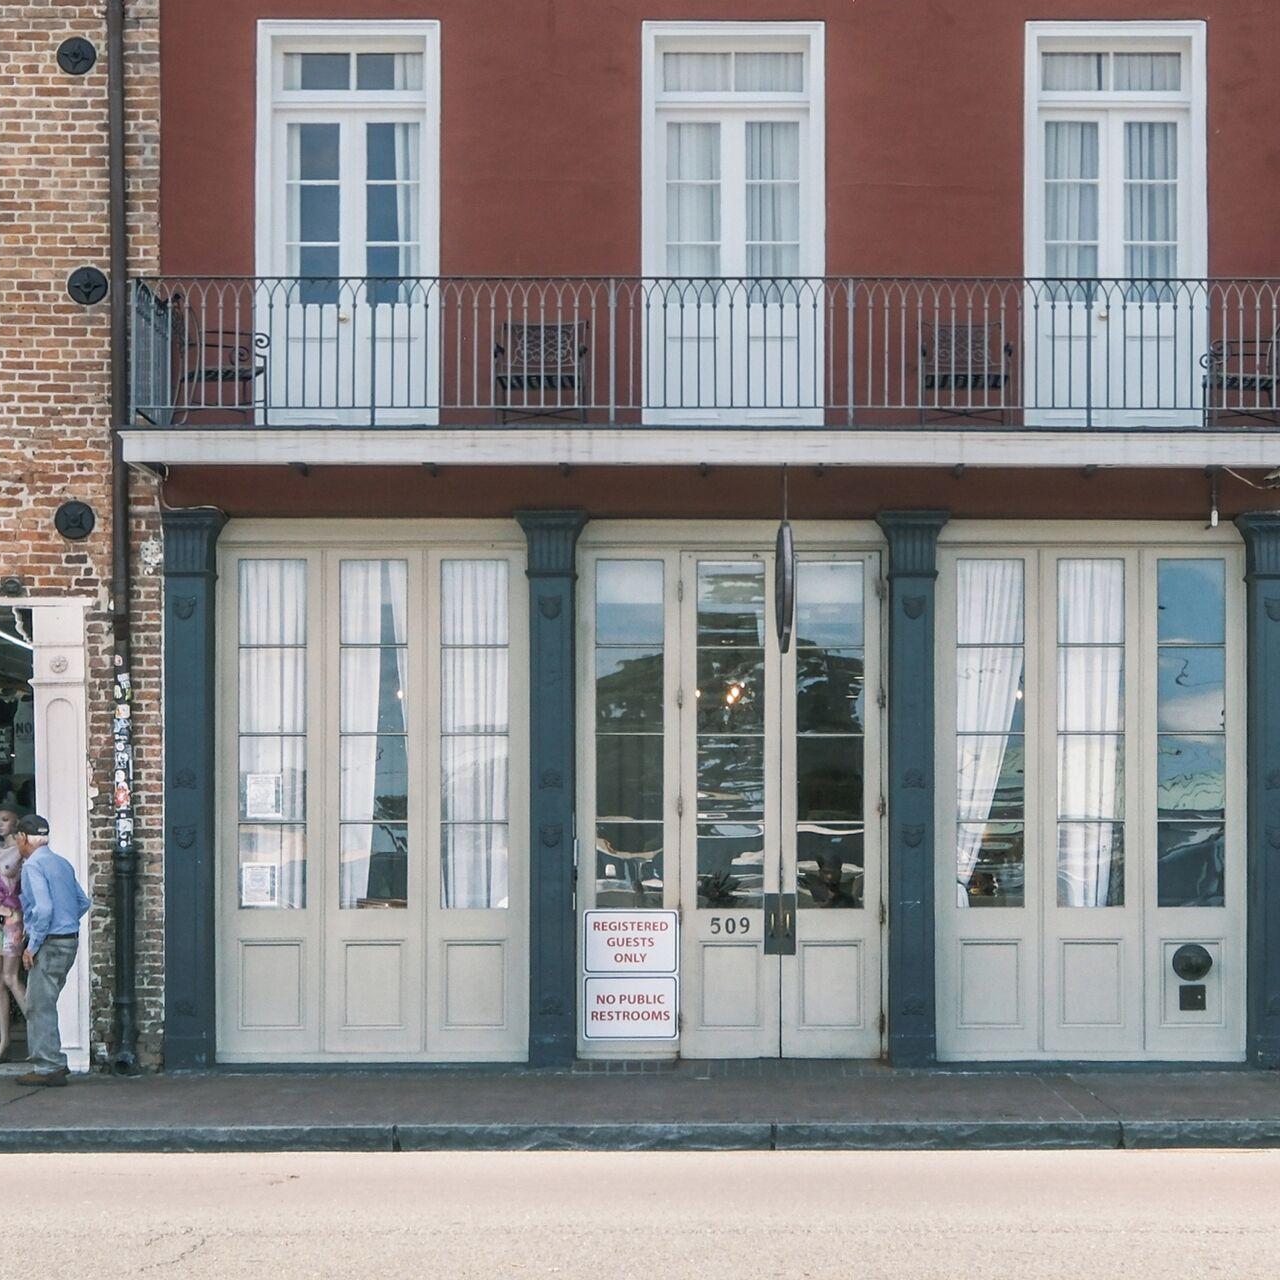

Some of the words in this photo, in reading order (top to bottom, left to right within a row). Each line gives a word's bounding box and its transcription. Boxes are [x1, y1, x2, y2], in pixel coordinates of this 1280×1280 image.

[592, 921, 669, 932] REGISTERED
[710, 917, 751, 935] 509
[606, 937, 655, 948] GUESTS
[613, 952, 648, 964] ONLY
[595, 994, 616, 1005] NO
[619, 994, 665, 1005] PUBLIC
[591, 1010, 671, 1022] RESTROOMS
